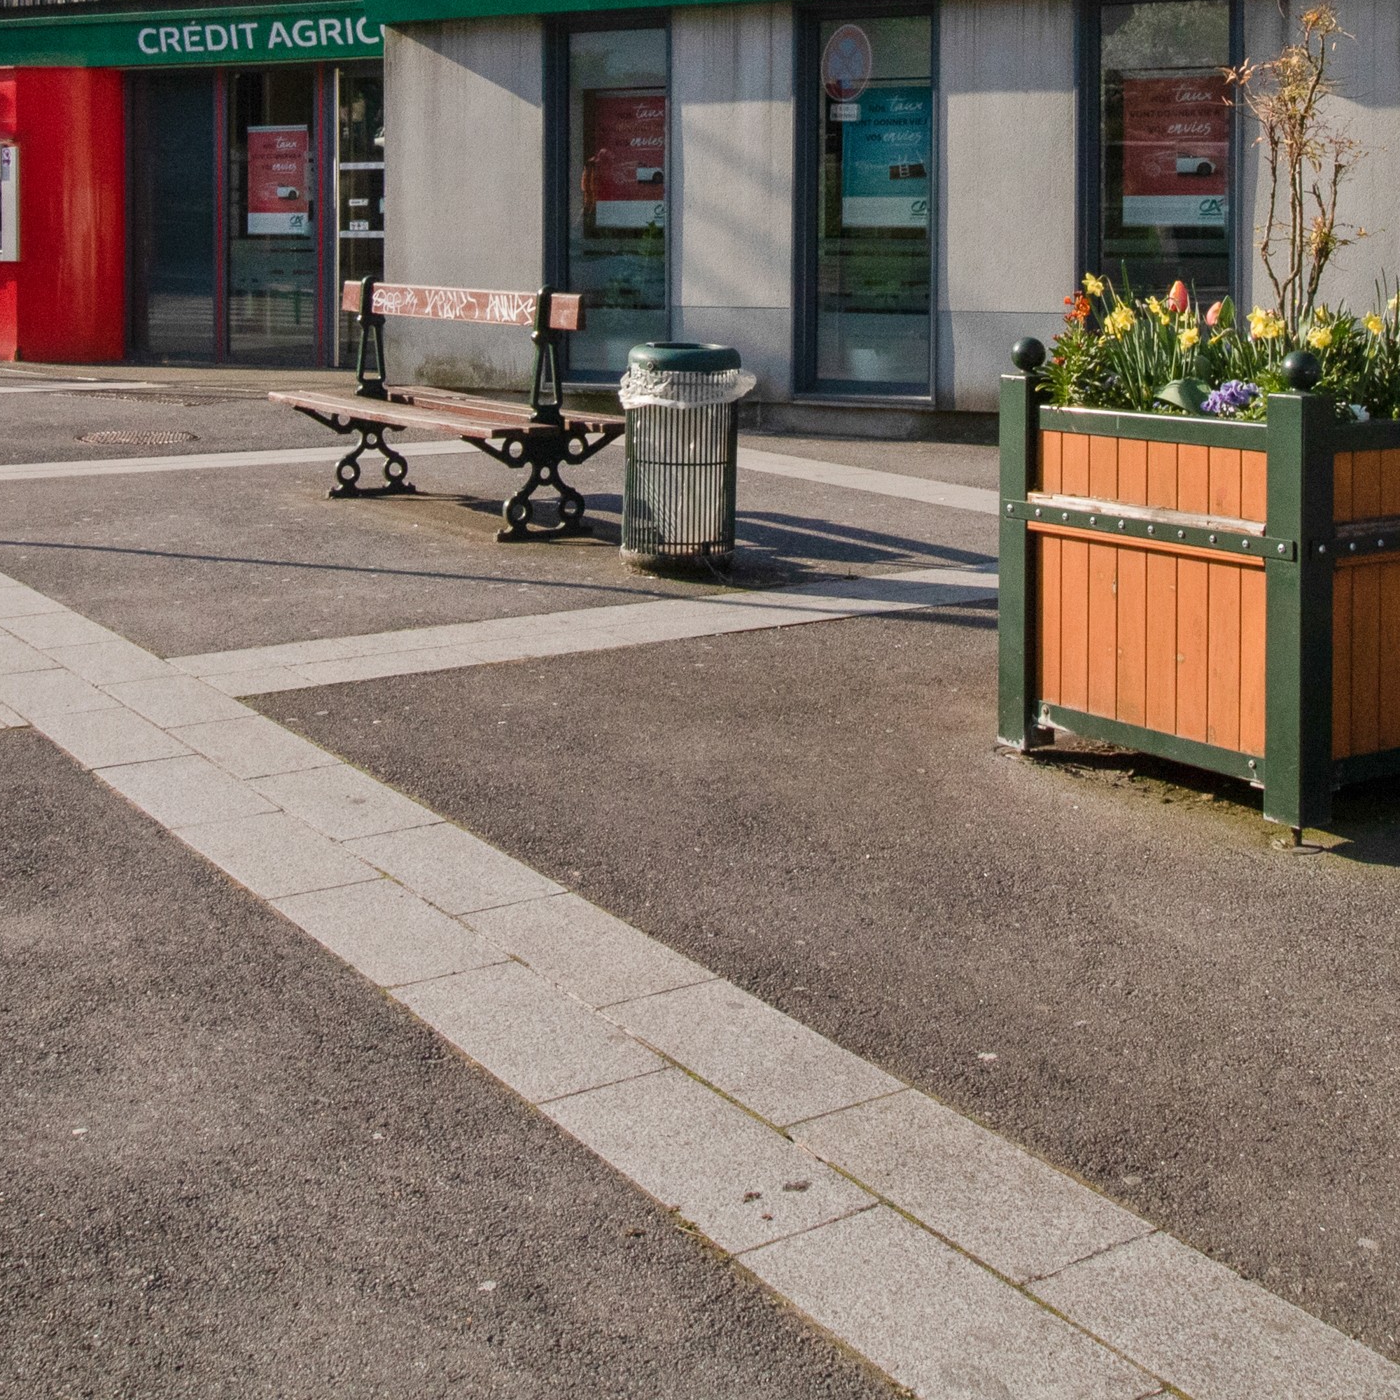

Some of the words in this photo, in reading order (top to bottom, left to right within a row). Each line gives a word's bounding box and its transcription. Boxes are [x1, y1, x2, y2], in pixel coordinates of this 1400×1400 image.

[137, 20, 258, 54] CRÉDIT
[267, 16, 385, 49] AGRIC
[1172, 84, 1213, 103] taux
[887, 95, 924, 112] taux
[1167, 121, 1211, 135] envies
[630, 137, 664, 148] envies
[883, 130, 923, 144] envies
